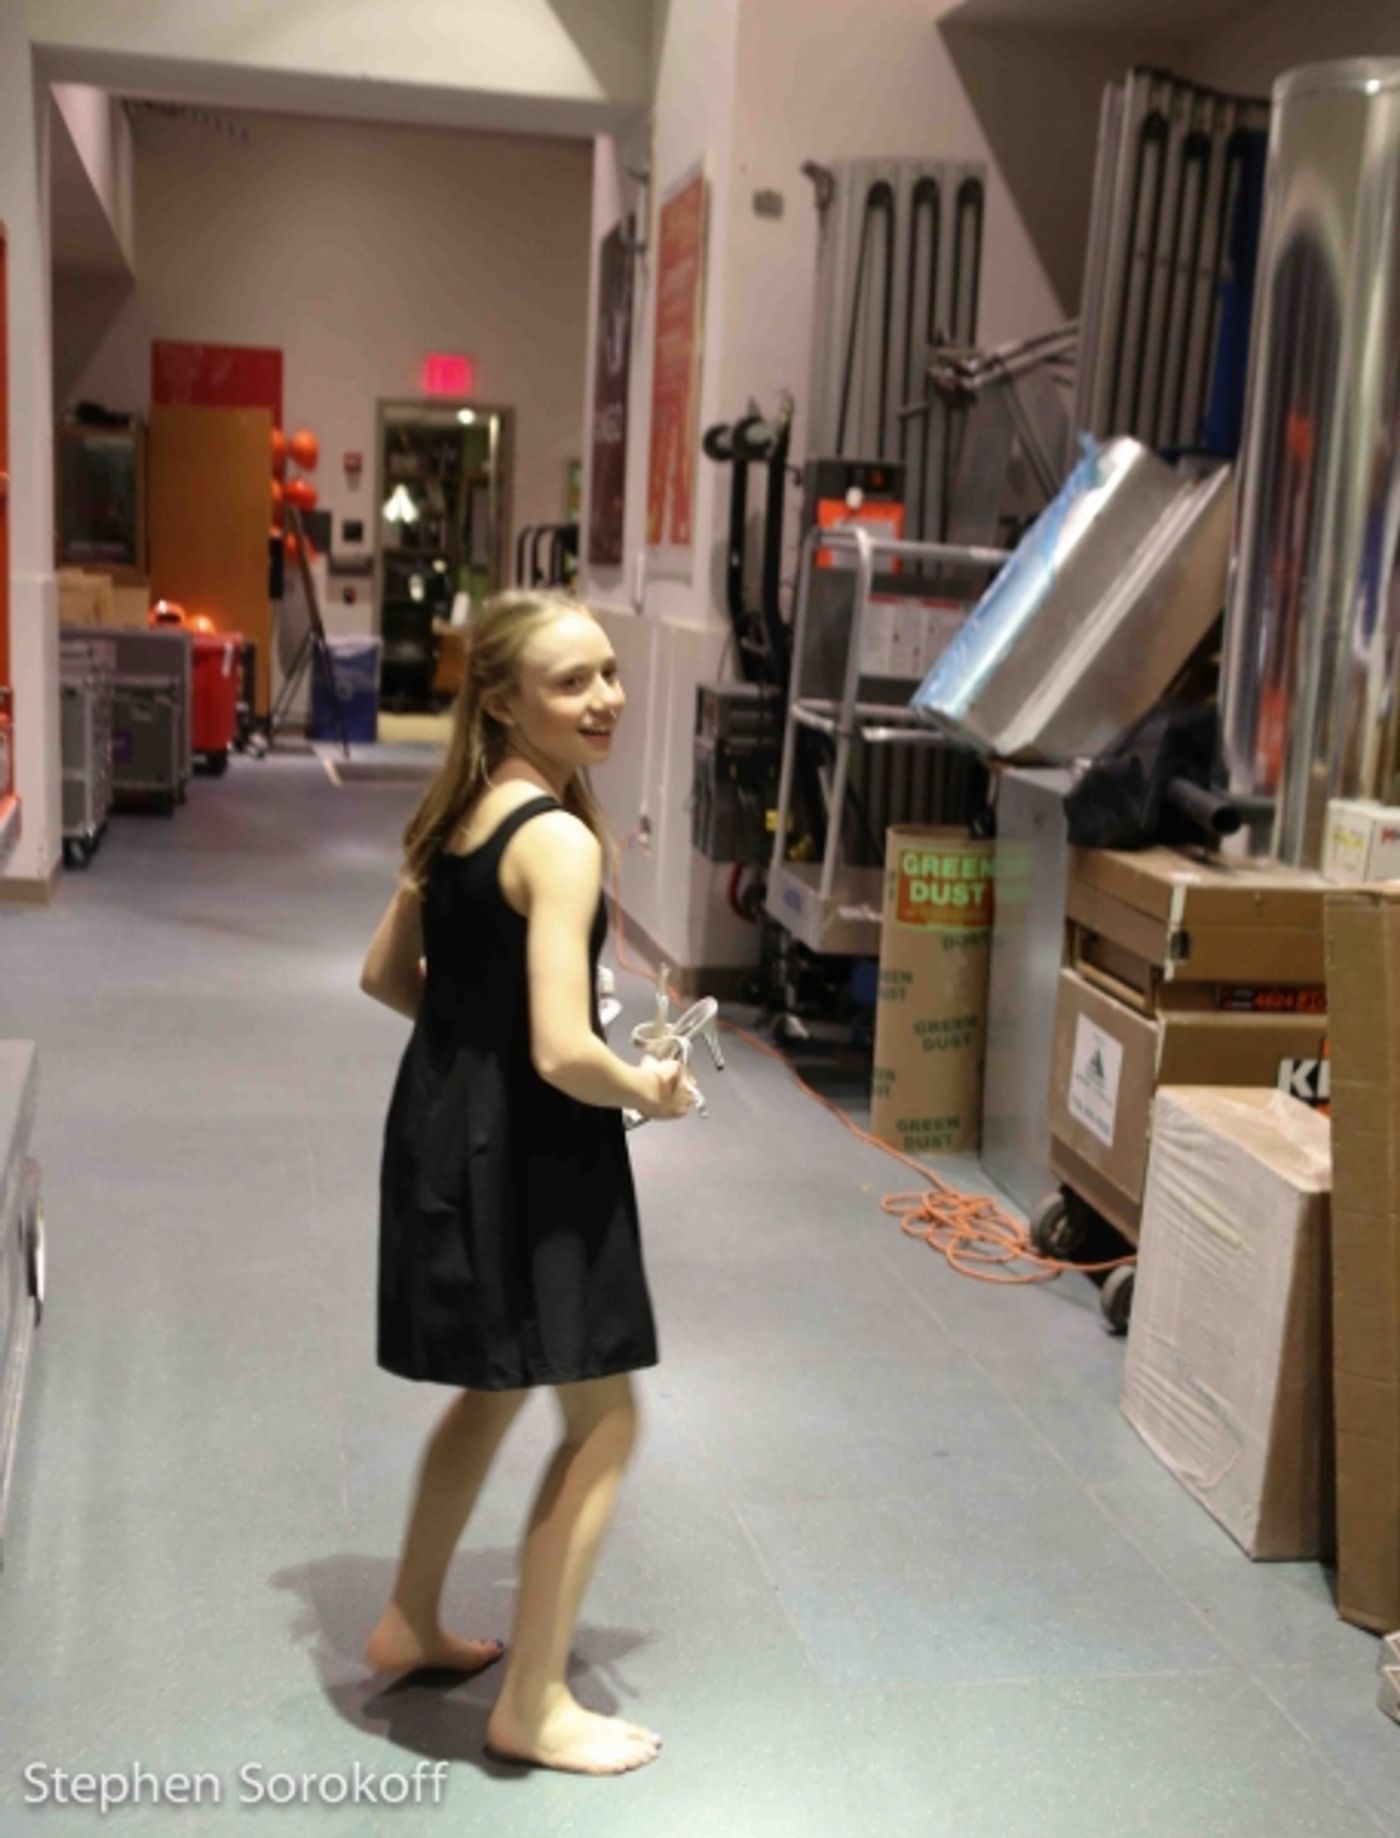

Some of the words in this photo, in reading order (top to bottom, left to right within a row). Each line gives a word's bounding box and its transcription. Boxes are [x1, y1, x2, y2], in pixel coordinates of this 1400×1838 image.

[910, 881, 986, 905] DUST
[913, 1015, 977, 1034] GREEN
[922, 1032, 972, 1052] DUST
[896, 1116, 960, 1133] GREEN
[904, 1133, 953, 1153] DUST
